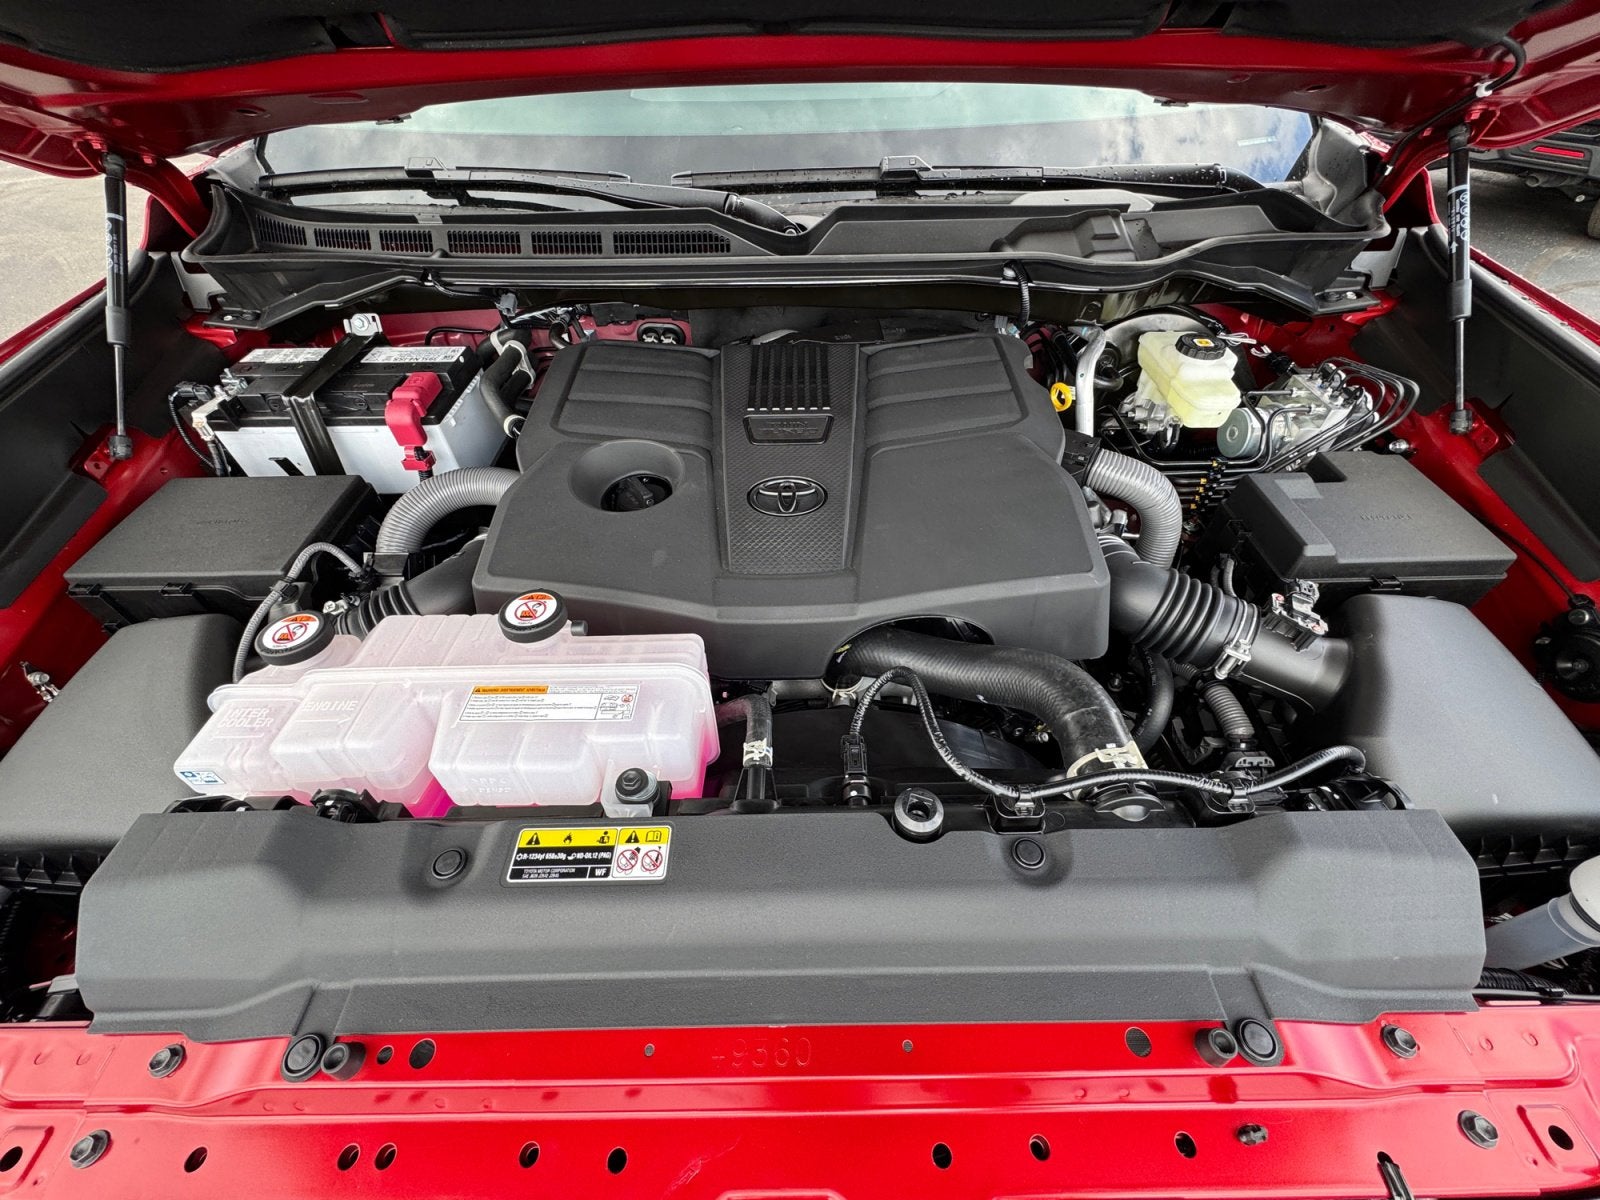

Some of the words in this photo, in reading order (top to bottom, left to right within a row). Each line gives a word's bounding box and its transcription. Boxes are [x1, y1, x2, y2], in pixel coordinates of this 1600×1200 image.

[301, 700, 359, 711] ENGINE
[225, 708, 270, 718] INTER
[217, 718, 274, 728] COOLER
[595, 868, 607, 876] WF
